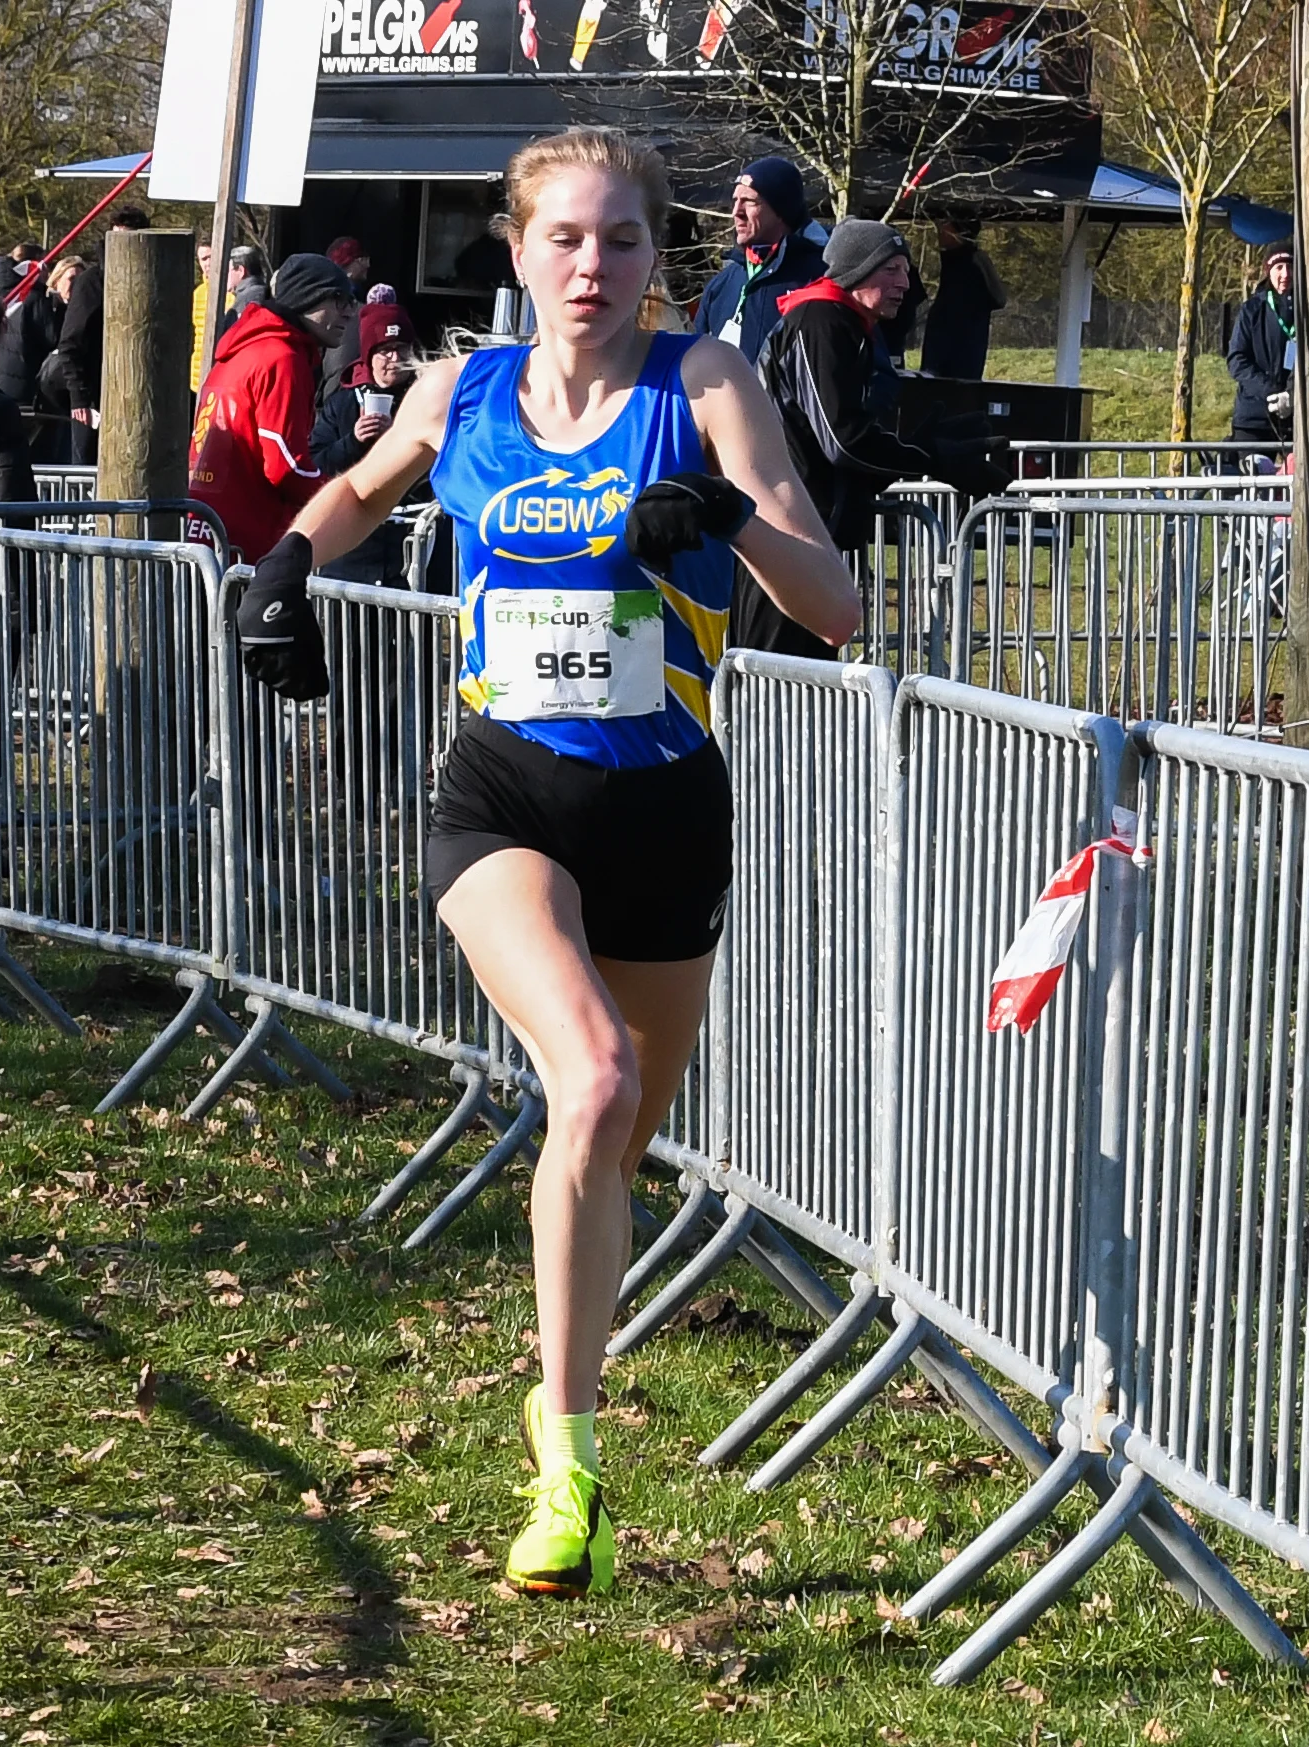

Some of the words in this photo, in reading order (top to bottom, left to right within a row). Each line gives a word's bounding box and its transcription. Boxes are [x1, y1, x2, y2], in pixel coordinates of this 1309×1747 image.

[322, 56, 477, 73] WWW.PELGRIMS.BE
[499, 496, 599, 534] USBW
[535, 651, 612, 679] 965
